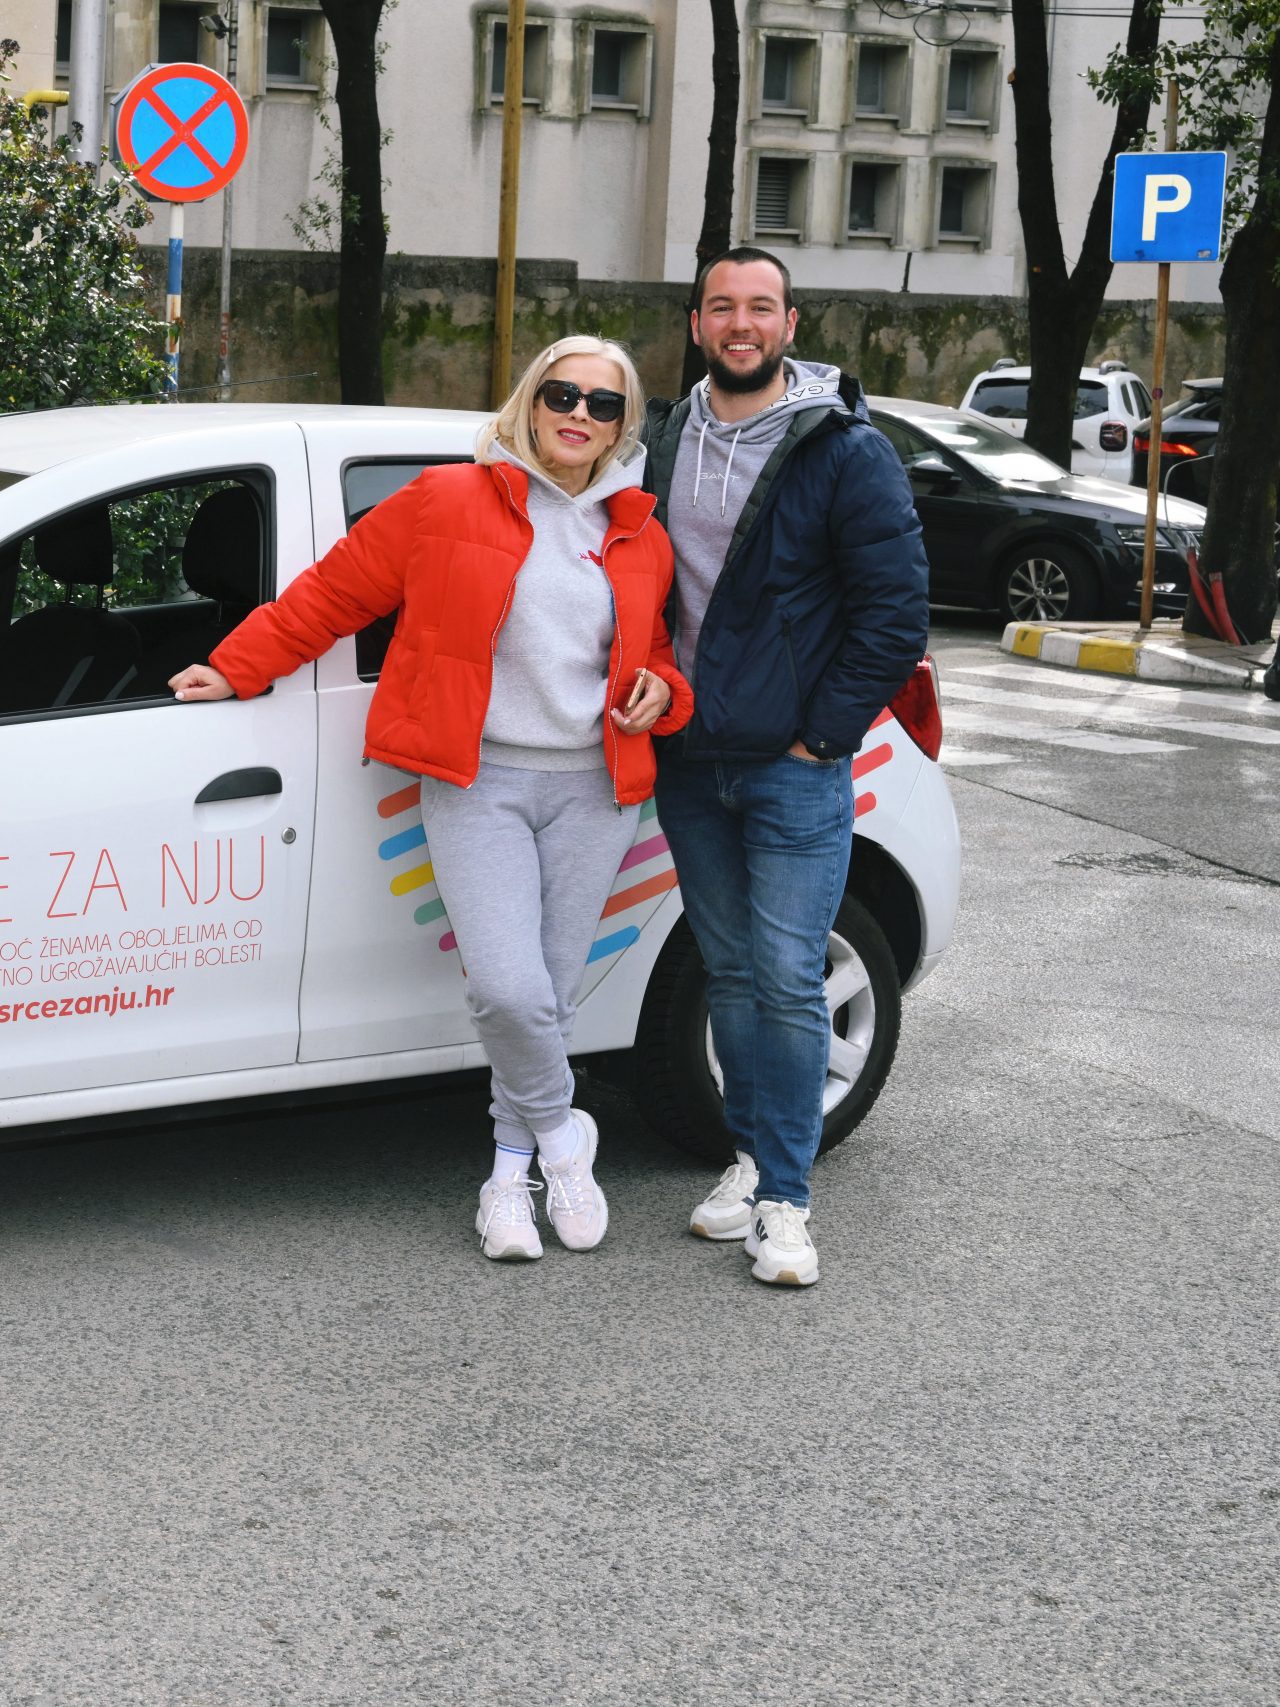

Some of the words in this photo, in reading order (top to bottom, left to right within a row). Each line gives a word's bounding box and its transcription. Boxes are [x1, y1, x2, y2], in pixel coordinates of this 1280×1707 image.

[1142, 174, 1192, 241] P
[46, 848, 128, 918] ZA
[161, 835, 265, 908] NJU
[39, 933, 112, 958] ŽENAMA
[118, 922, 228, 950] OBOLJELIMA
[233, 919, 263, 939] OD
[39, 949, 187, 983] UGROŽAVAJUĆIH
[194, 943, 263, 967] BOLESTI
